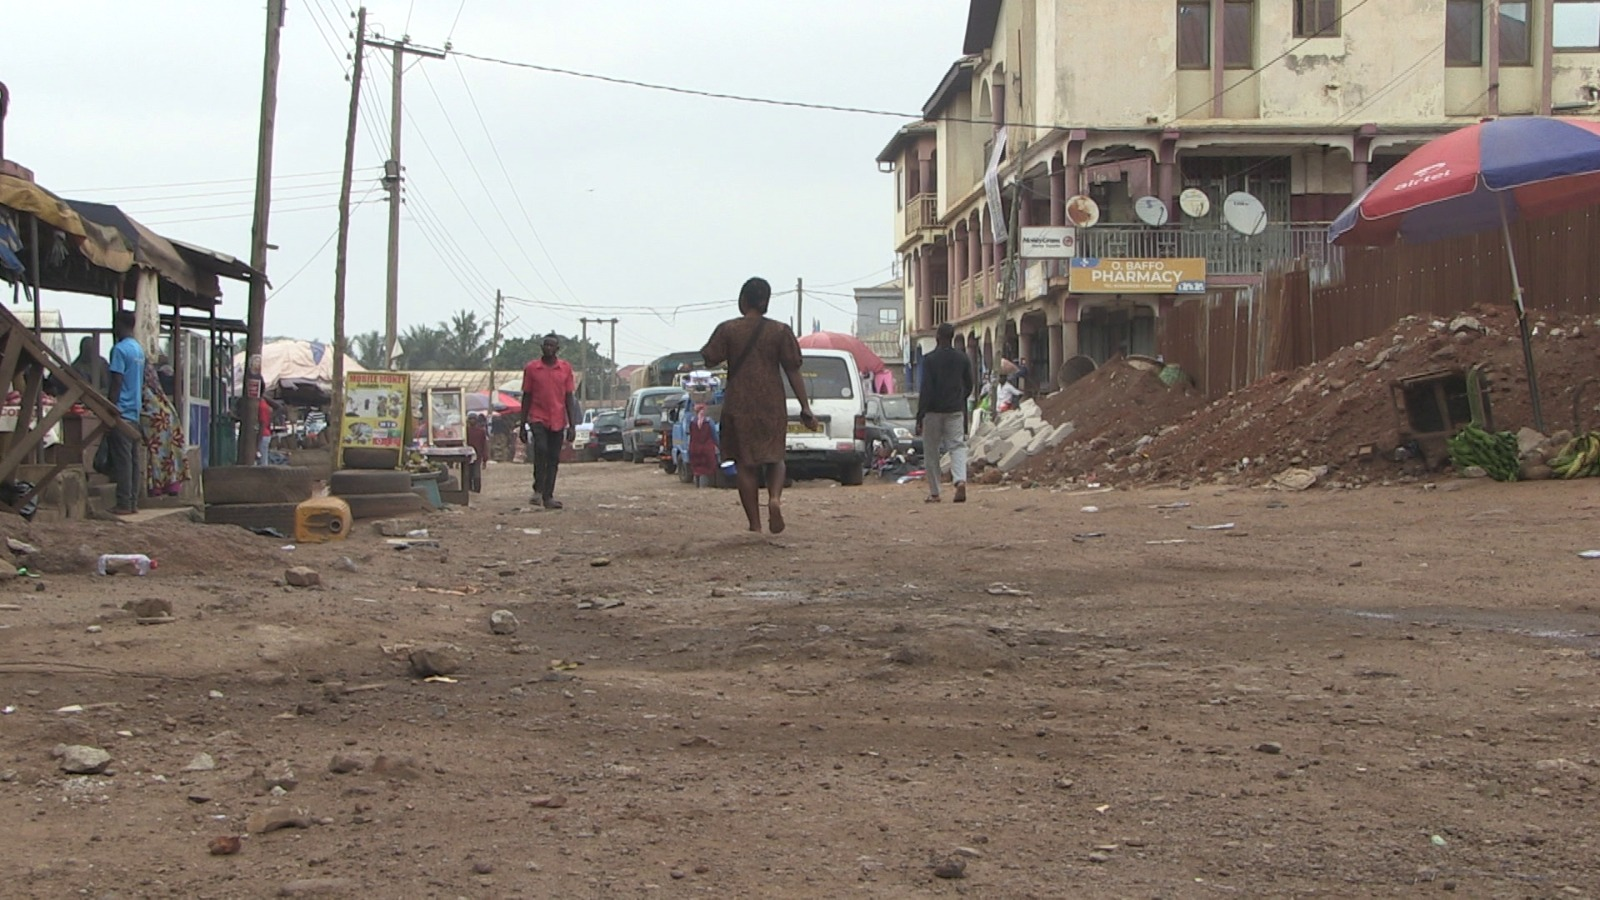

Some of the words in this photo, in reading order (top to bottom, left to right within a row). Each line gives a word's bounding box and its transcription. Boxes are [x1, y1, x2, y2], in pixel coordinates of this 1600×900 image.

[1393, 169, 1451, 191] airtel
[1111, 261, 1123, 271] O.
[1126, 261, 1164, 271] BAFFO
[1091, 270, 1183, 283] PHARMACY
